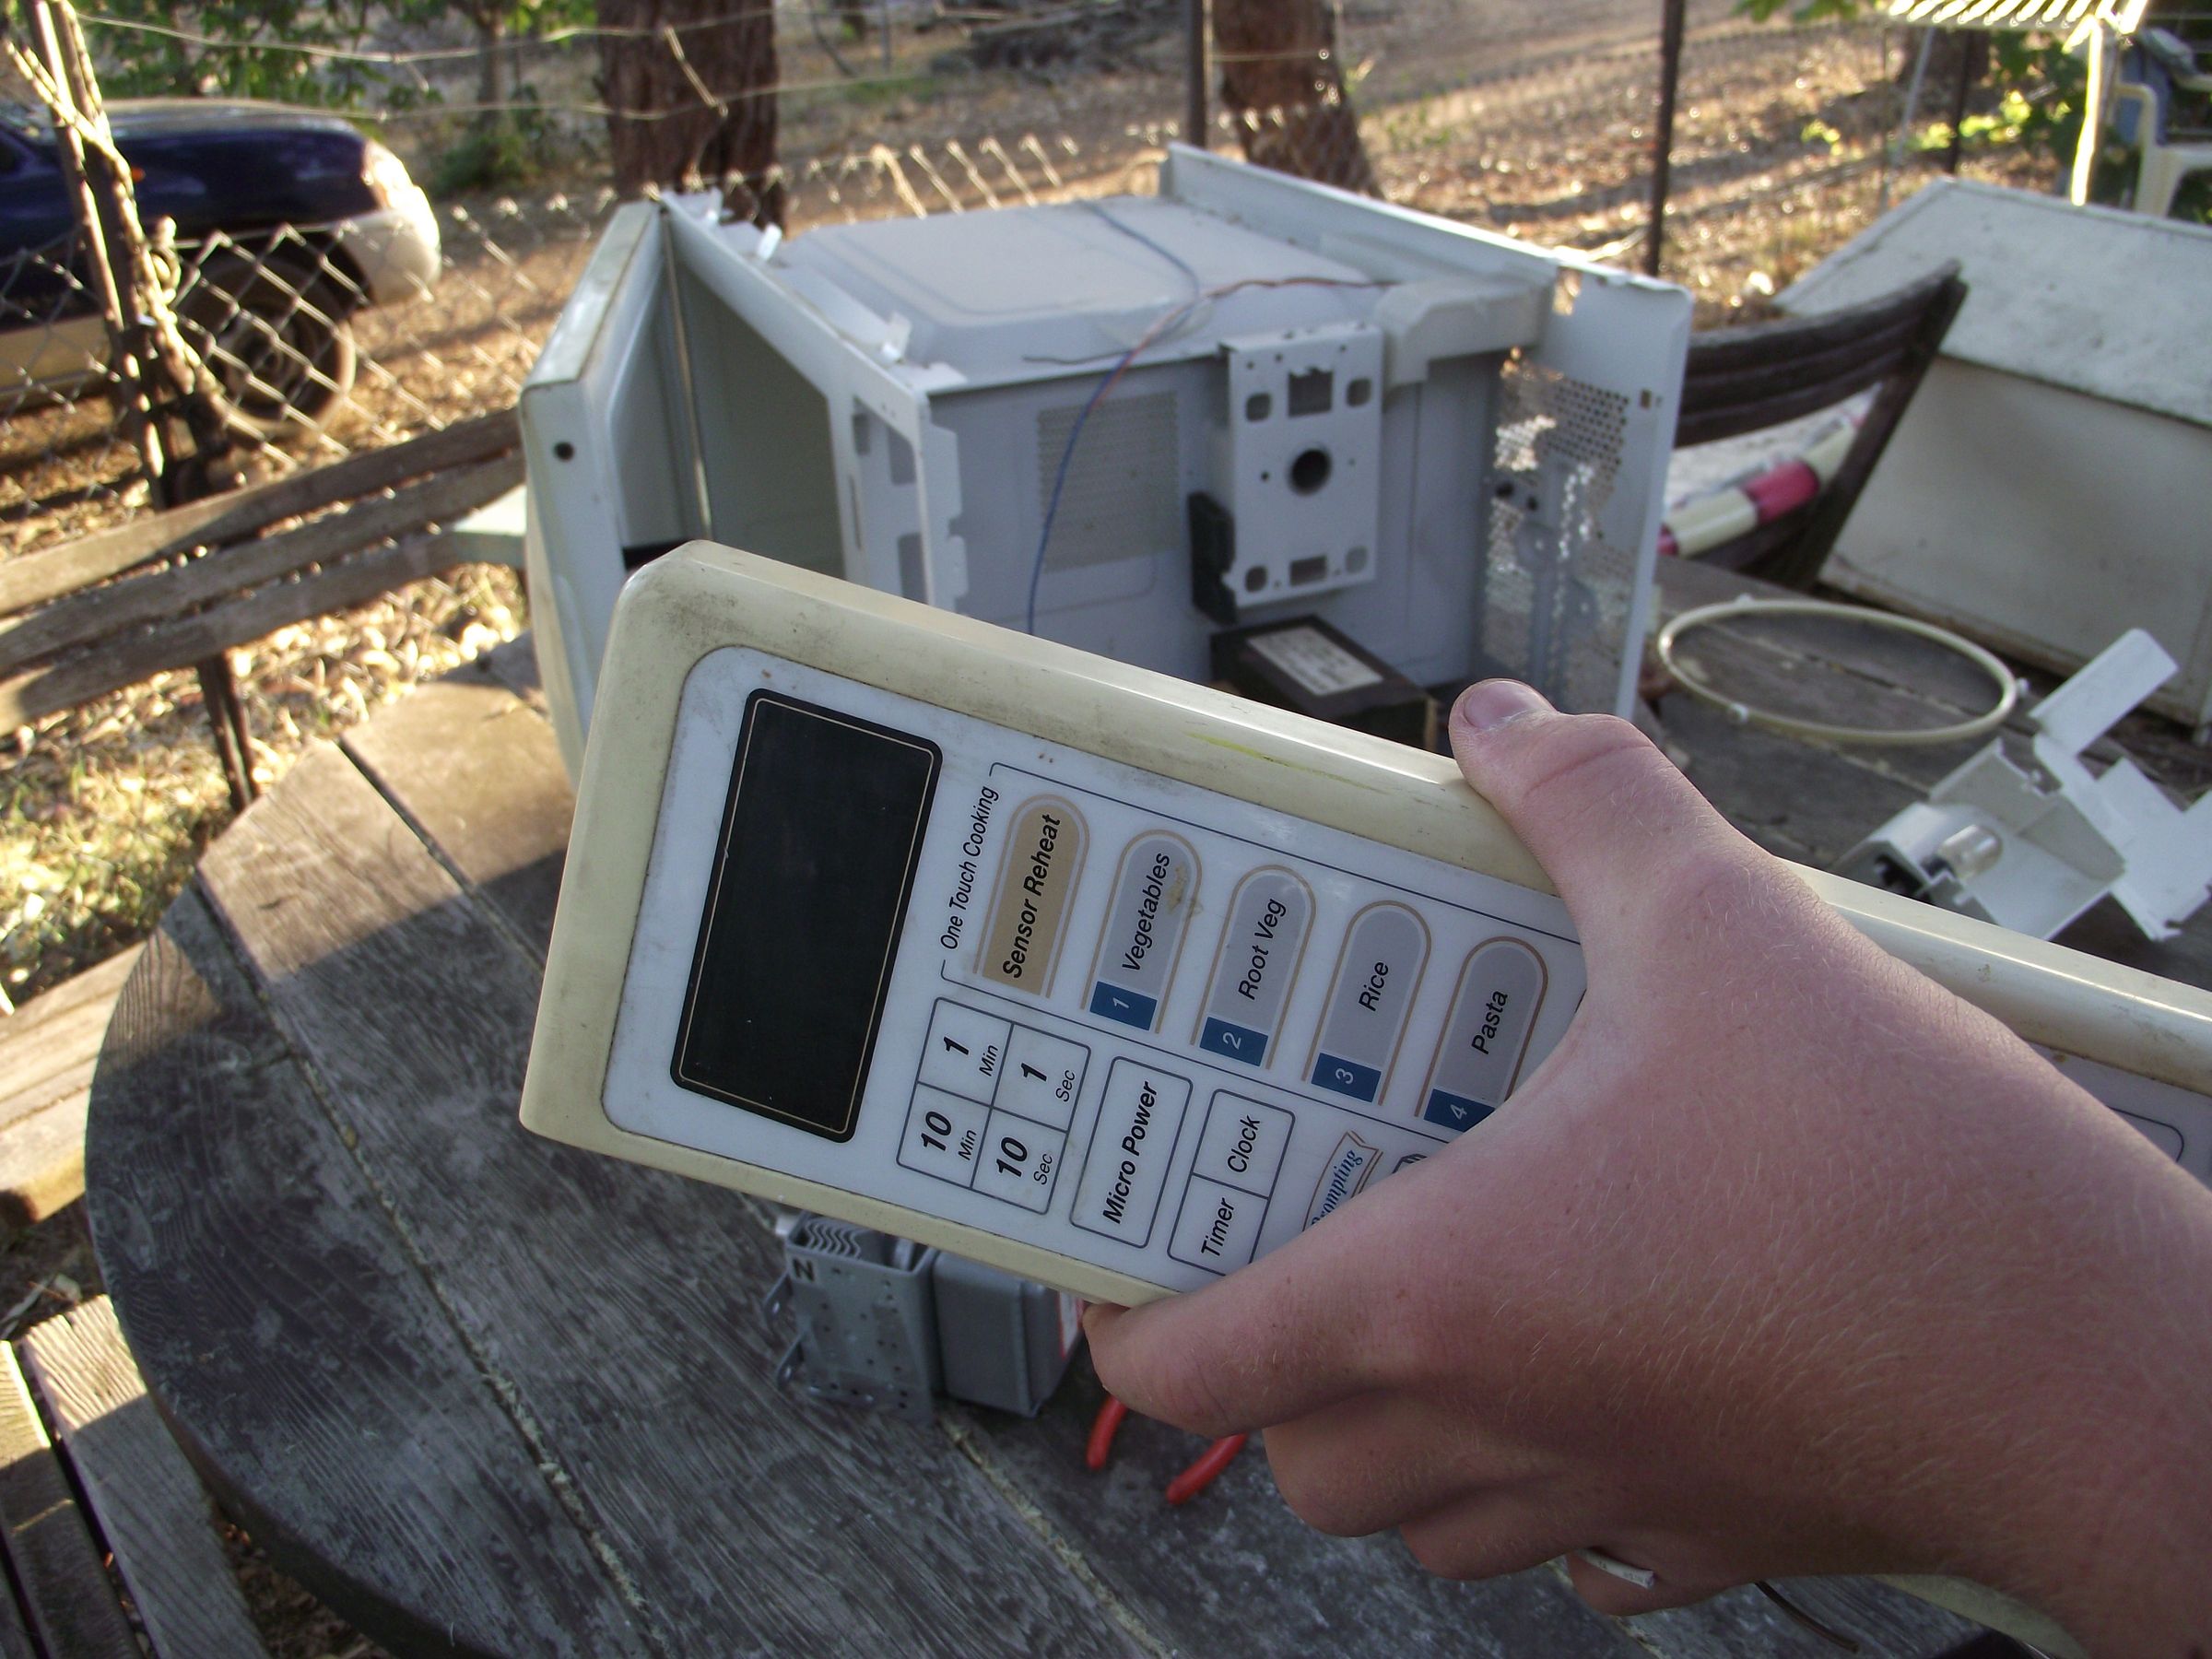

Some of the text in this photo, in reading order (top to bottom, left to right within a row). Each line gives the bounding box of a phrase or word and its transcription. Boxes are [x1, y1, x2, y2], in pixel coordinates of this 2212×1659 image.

[940, 786, 999, 949] One Touch Cooking
[1003, 814, 1061, 978] Sensor Reheat
[1122, 853, 1170, 971] Vegetables
[1238, 899, 1287, 1000] Root Veg
[1112, 997, 1130, 1009] 1
[1359, 961, 1389, 1012] Rice
[1223, 1031, 1241, 1050] 2
[1471, 991, 1508, 1054] Pasta
[943, 1036, 970, 1055] 1
[979, 1045, 998, 1077] Min
[1021, 1063, 1047, 1081] 1
[1055, 1070, 1076, 1101] Sec
[1335, 1067, 1354, 1085] 3
[921, 1111, 952, 1151] 10
[1450, 1104, 1467, 1120] 4
[958, 1130, 977, 1160] Min
[996, 1137, 1028, 1177] 10
[1102, 1081, 1158, 1224] Micro Power
[1227, 1115, 1260, 1172] Clock
[1033, 1154, 1053, 1185] Sec
[1201, 1197, 1235, 1256] Timer
